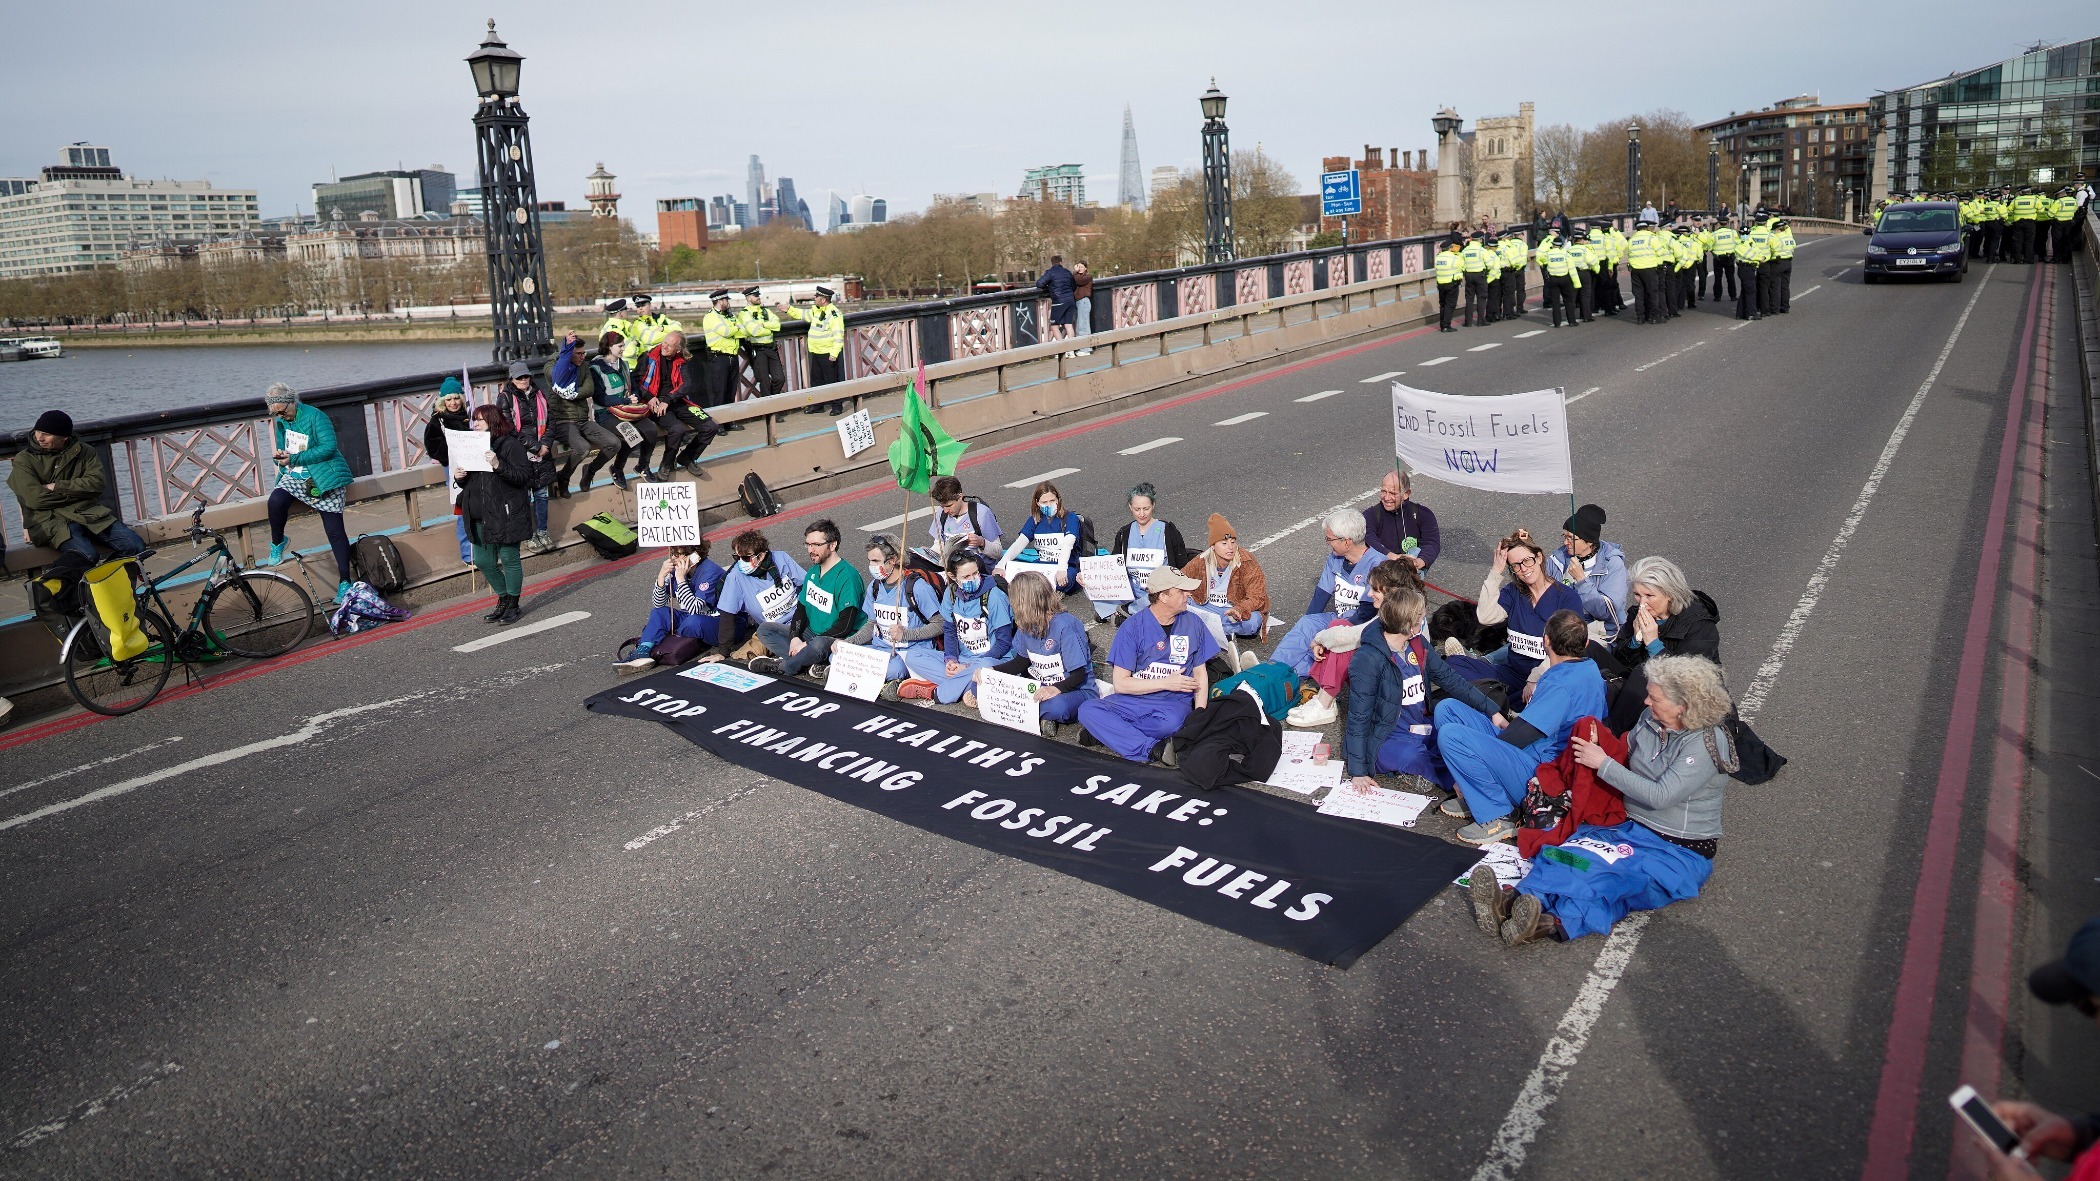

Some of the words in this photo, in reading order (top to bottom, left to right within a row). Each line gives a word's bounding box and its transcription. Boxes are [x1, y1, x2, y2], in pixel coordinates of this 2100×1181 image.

[1397, 406, 1420, 432] END
[1426, 410, 1475, 437] Fossil
[1490, 413, 1549, 437] Fuels
[1444, 448, 1497, 473] NOW
[640, 487, 643, 499] I
[645, 487, 660, 500] AM
[662, 486, 692, 500] HERE
[641, 506, 663, 520] FOR
[668, 504, 690, 520] MY
[641, 526, 696, 542] PATIENTS
[1099, 561, 1114, 570] HERE
[1131, 553, 1154, 562] NURSE
[764, 579, 792, 604] DOCTOR
[808, 588, 828, 606] DOCTOR
[1335, 584, 1359, 600] OCTOR
[985, 674, 996, 685] 30
[761, 692, 840, 718] FOR
[852, 715, 1046, 777] HEALTH'S
[1070, 775, 1228, 826] SAKE:
[618, 689, 707, 718] STOP
[711, 720, 924, 791] FINANCING
[941, 790, 1112, 851] FOSSIL
[1148, 846, 1334, 922] FUELS
